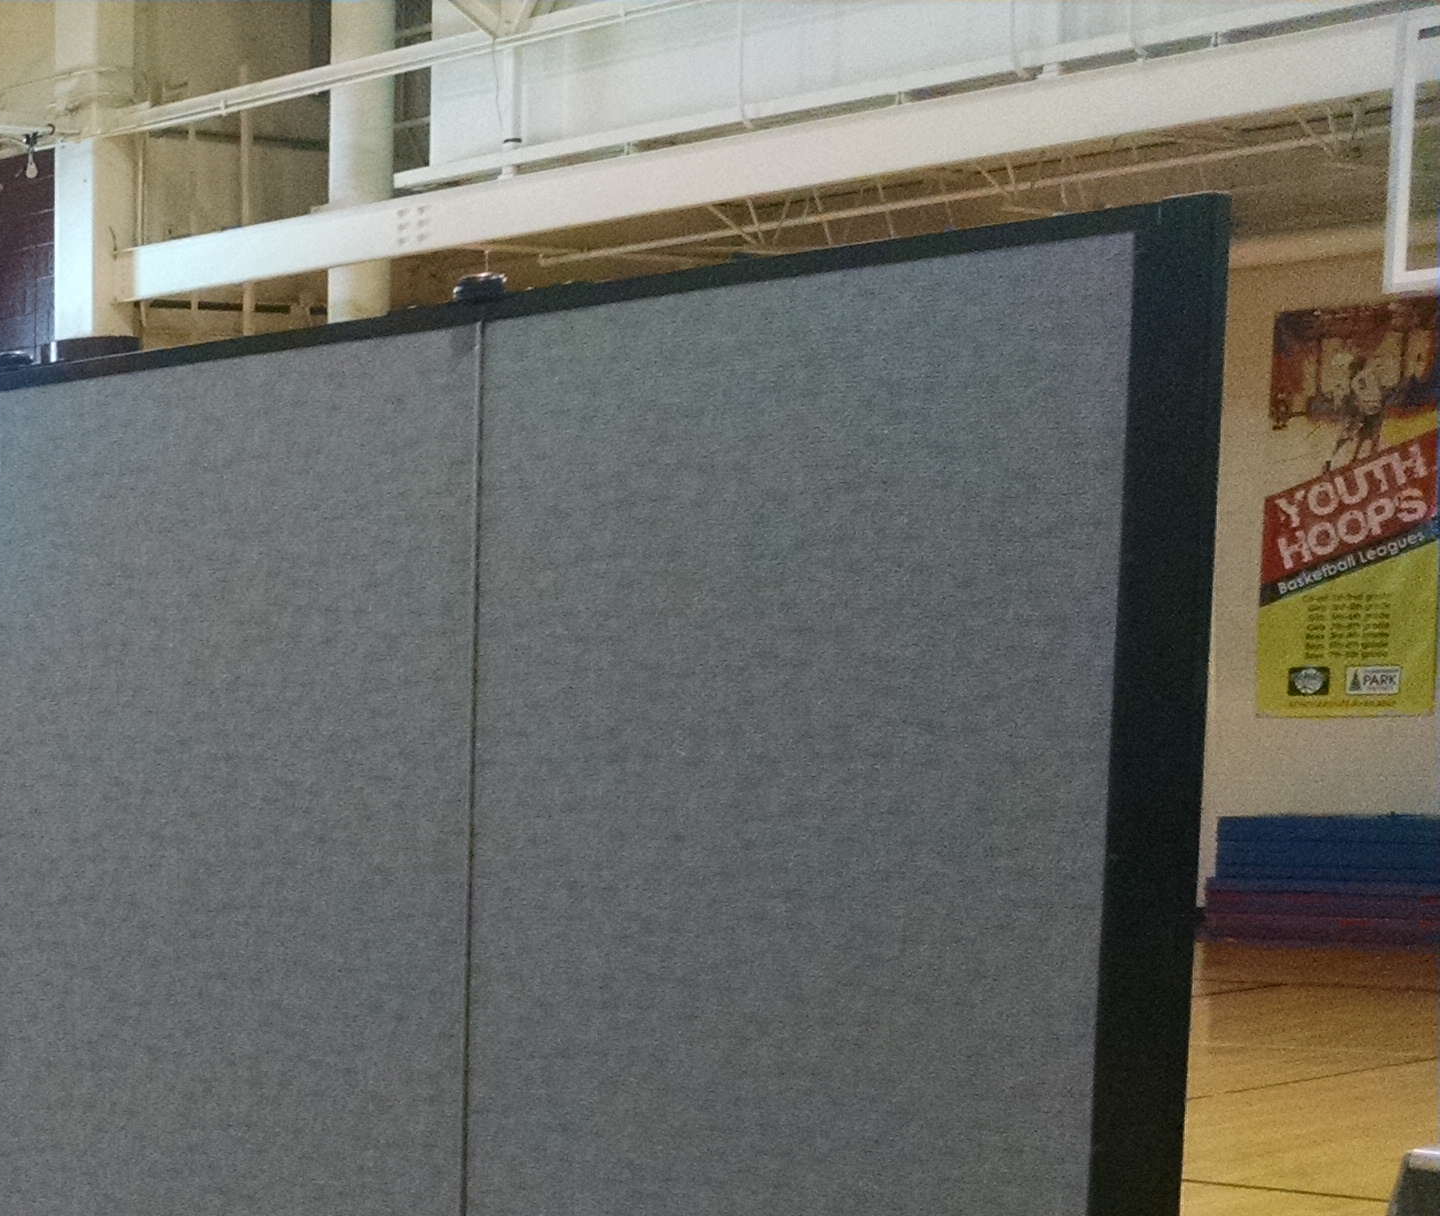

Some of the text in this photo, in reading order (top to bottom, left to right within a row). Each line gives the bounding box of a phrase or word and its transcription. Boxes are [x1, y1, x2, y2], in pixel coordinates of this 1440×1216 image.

[1274, 443, 1428, 528] YOUTH
[1277, 487, 1428, 570] HOOPS
[1278, 531, 1425, 595] Basketball Leagues
[1363, 674, 1397, 686] PARK
